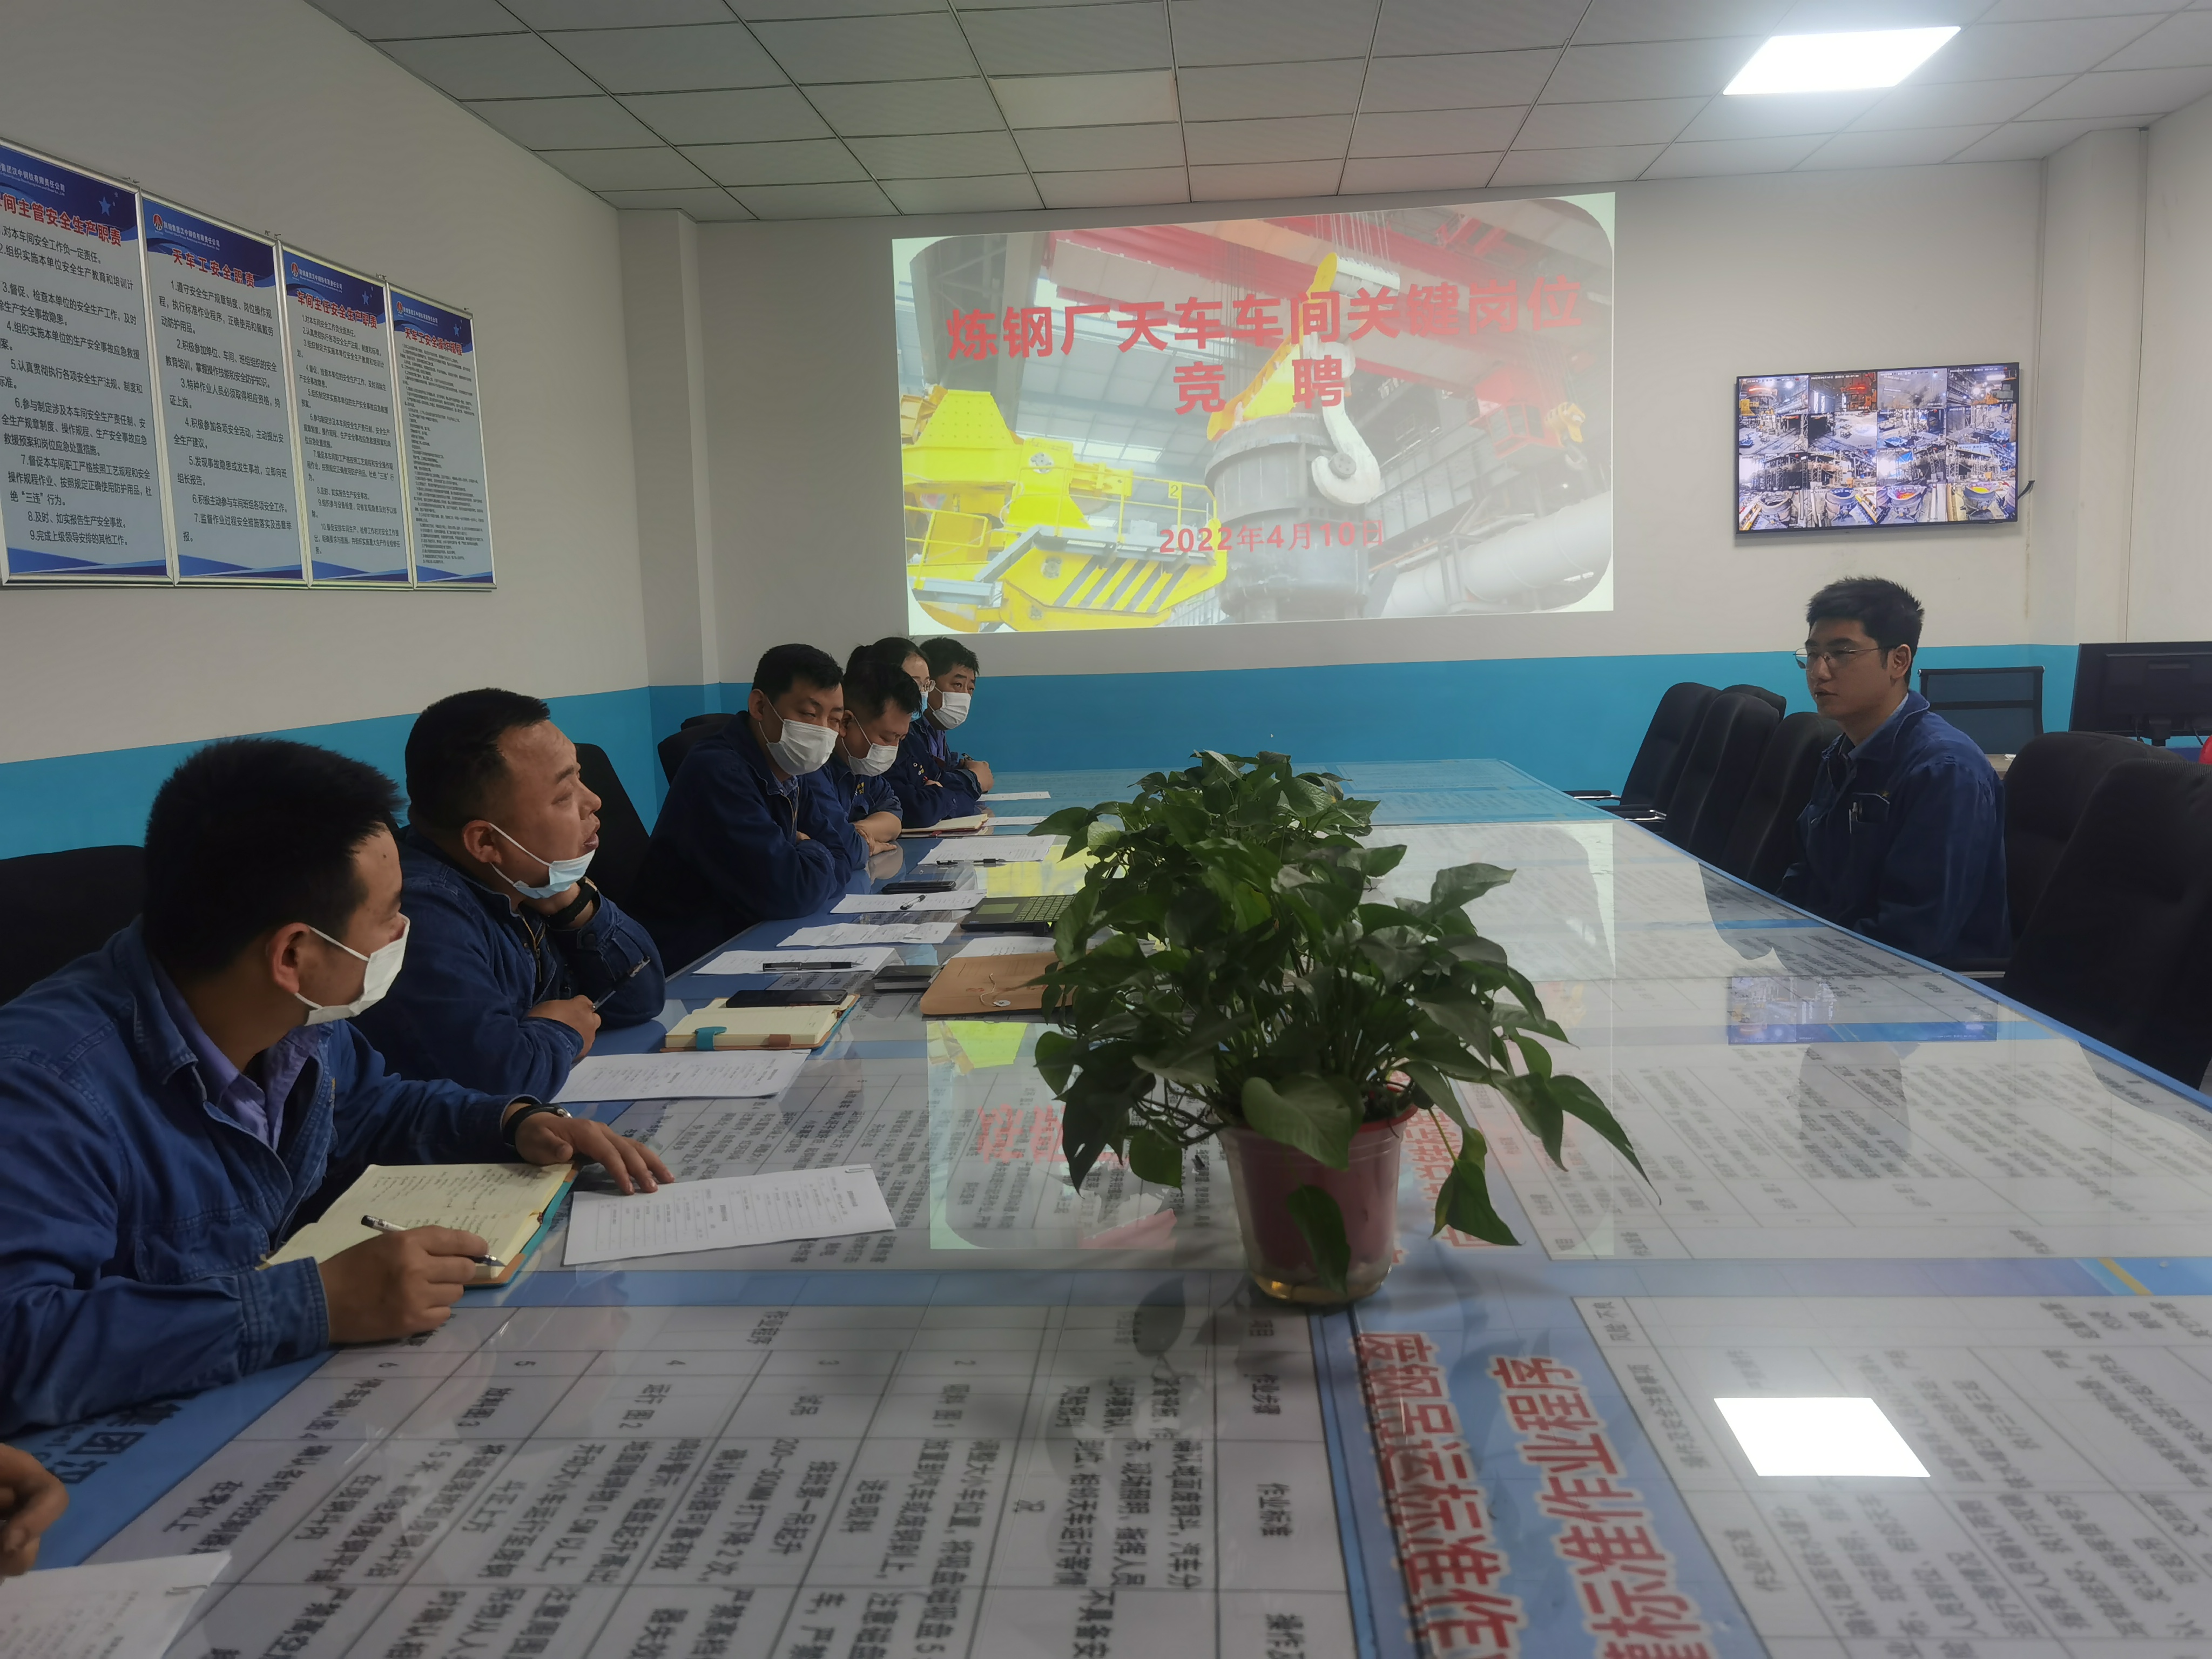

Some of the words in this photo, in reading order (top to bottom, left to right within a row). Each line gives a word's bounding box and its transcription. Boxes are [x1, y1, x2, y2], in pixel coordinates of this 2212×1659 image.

[0, 191, 122, 247] 间主管安全生产职责
[0, 224, 102, 266] .对本车间安全工作负一定责任。
[171, 247, 255, 289] 天车工安全职责
[160, 316, 196, 334] 动防护用品。
[296, 290, 377, 329] 车间主任安全生产职责
[946, 275, 1582, 360] 炼钢厂天车车间关键岗位
[170, 395, 192, 409] 证上岗。
[1174, 360, 1225, 415] 竞
[1291, 354, 1345, 409] 聘
[3, 433, 100, 456] 救援预案和岗位应急处置措施。
[173, 434, 207, 449] 全生产建议。
[177, 473, 205, 486] 组长报告。
[28, 511, 126, 529] 8.及时、如实报告生产安全事故。
[30, 530, 127, 545] 9.完成上级领导安排的其他工作。
[1159, 520, 1383, 552] 2022年4月10日
[744, 1311, 790, 1344] 作业程序
[1251, 1374, 1282, 1414] 作业步骤
[1625, 1364, 1713, 1468] 操作及安全注意事项
[158, 1481, 249, 1532] 在零位上
[291, 1475, 387, 1540] 在废钢斗内
[457, 1480, 532, 1534] 斗正上方
[1257, 1483, 1294, 1537] 作业标准
[1359, 1332, 1519, 1659] 废钢吊运标准作
